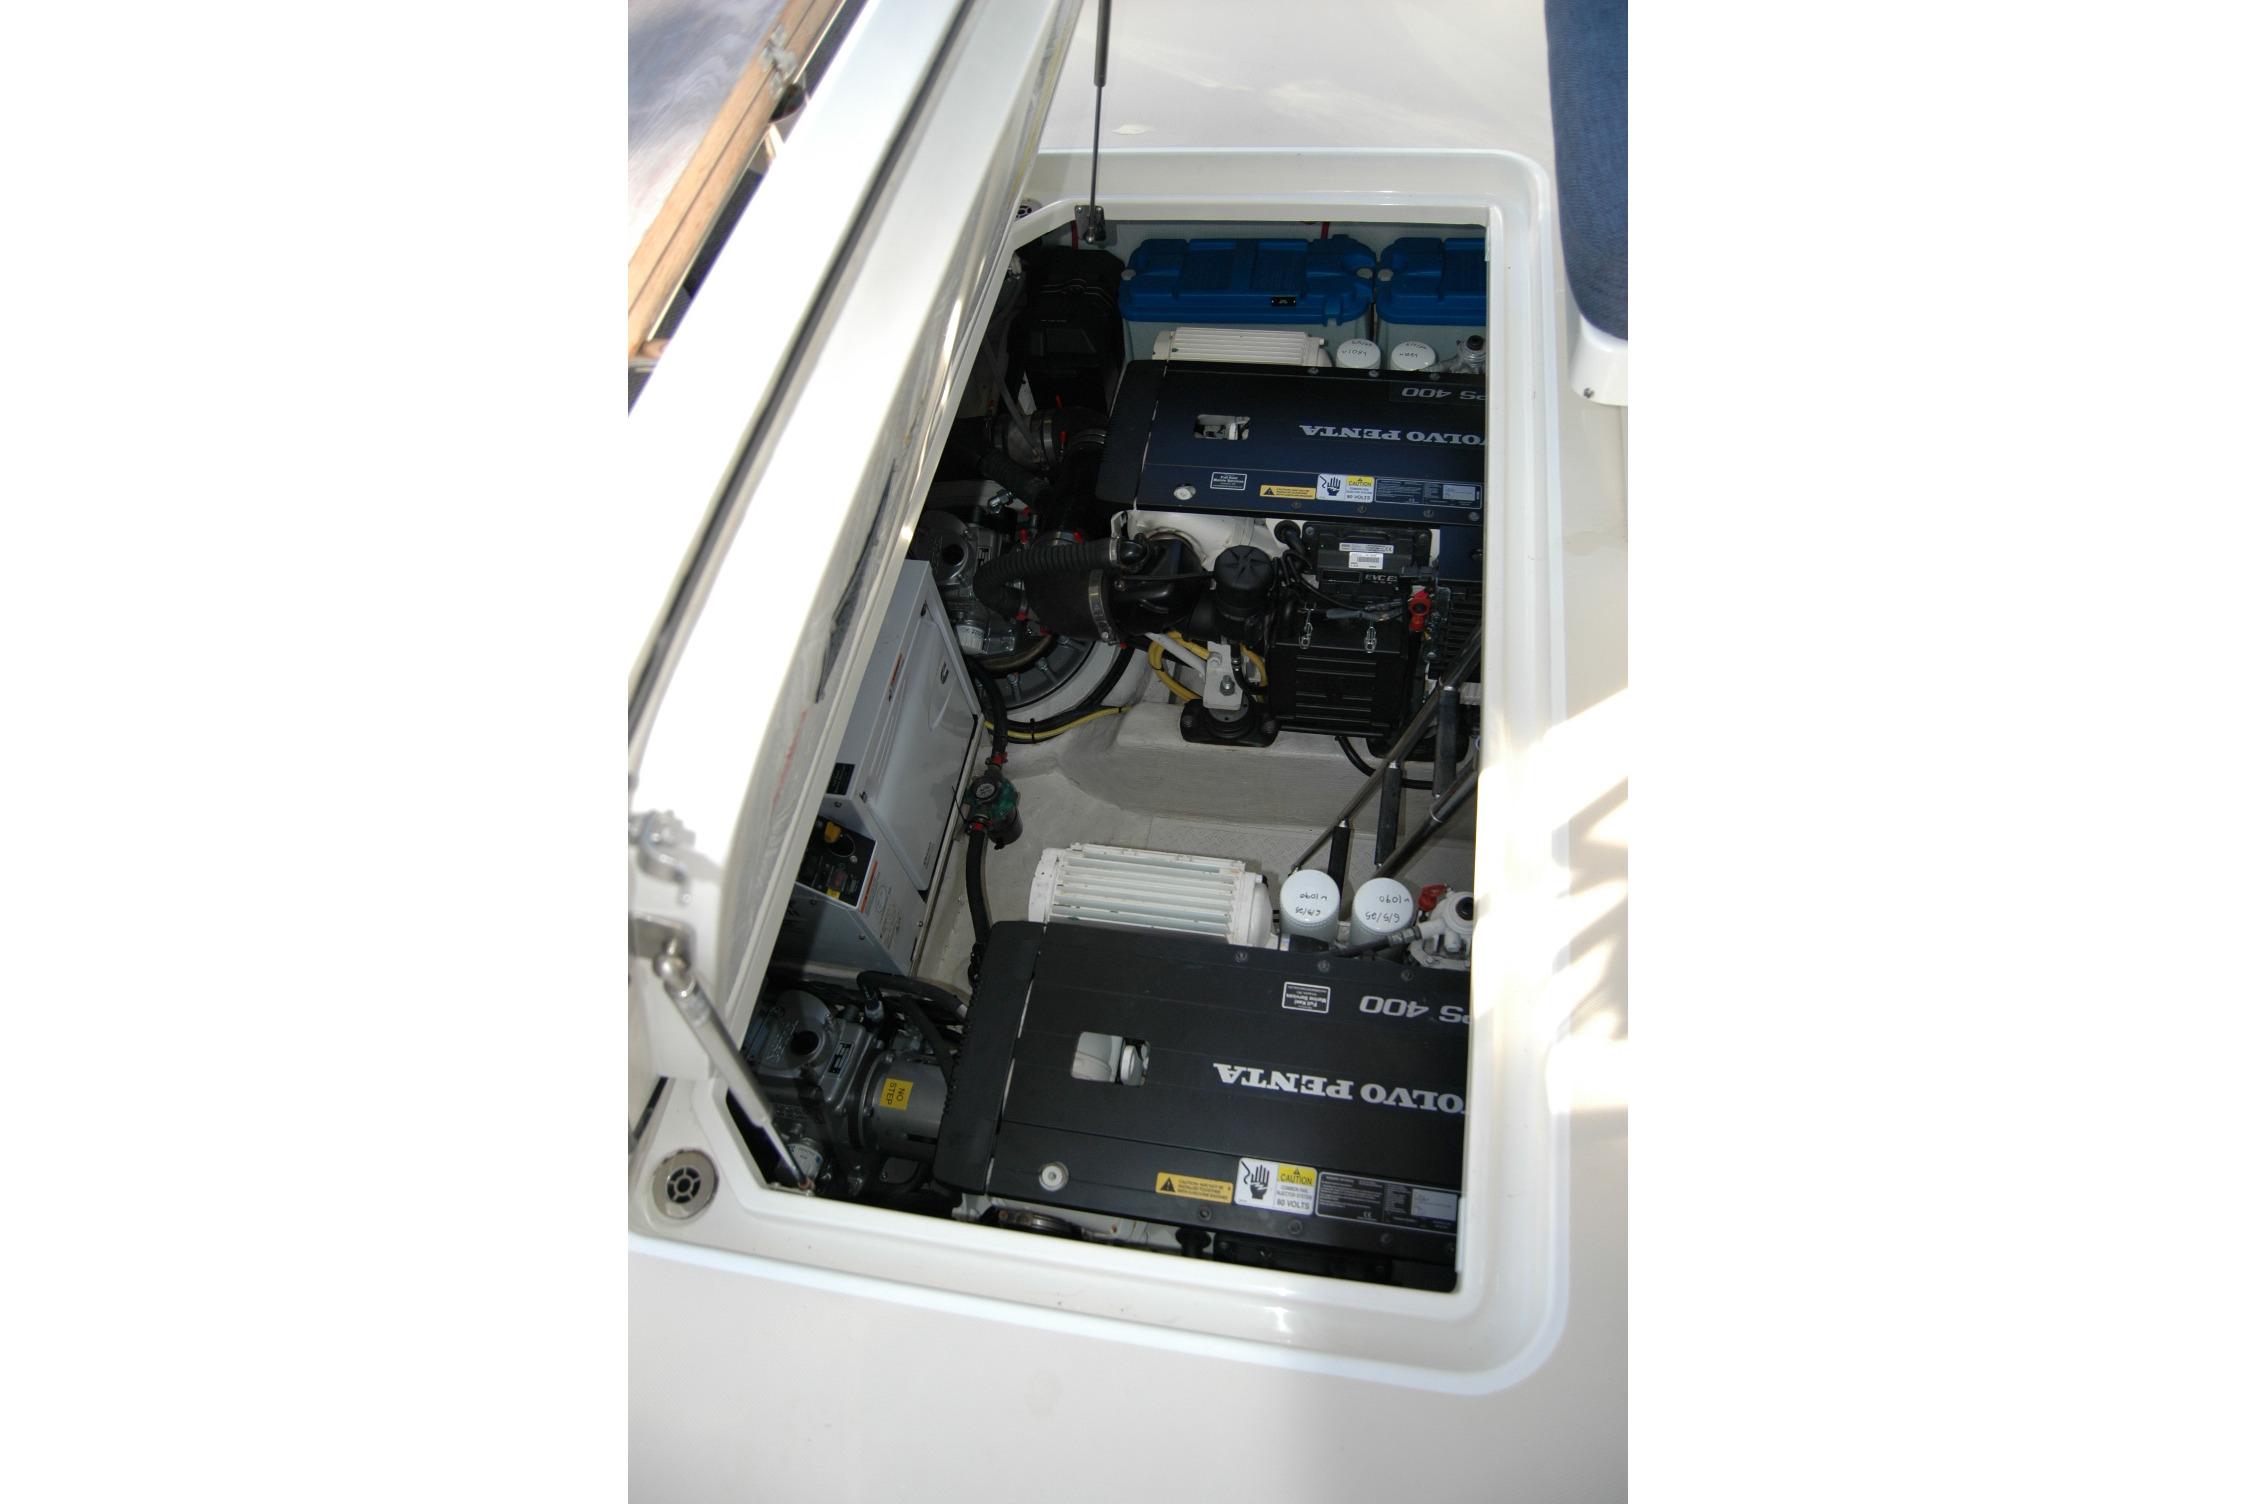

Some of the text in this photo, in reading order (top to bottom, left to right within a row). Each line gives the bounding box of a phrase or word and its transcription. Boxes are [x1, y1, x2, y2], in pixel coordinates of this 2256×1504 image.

[1402, 387, 1452, 399] 400
[1299, 425, 1486, 446] OLVO PENTA
[1359, 995, 1429, 1018] 400
[886, 1082, 897, 1105] STEP
[896, 1088, 905, 1101] NO
[1213, 1063, 1466, 1115] OLVO PENTA
[1280, 1173, 1312, 1185] CAUTION
[1287, 1200, 1310, 1210] VOLTS
